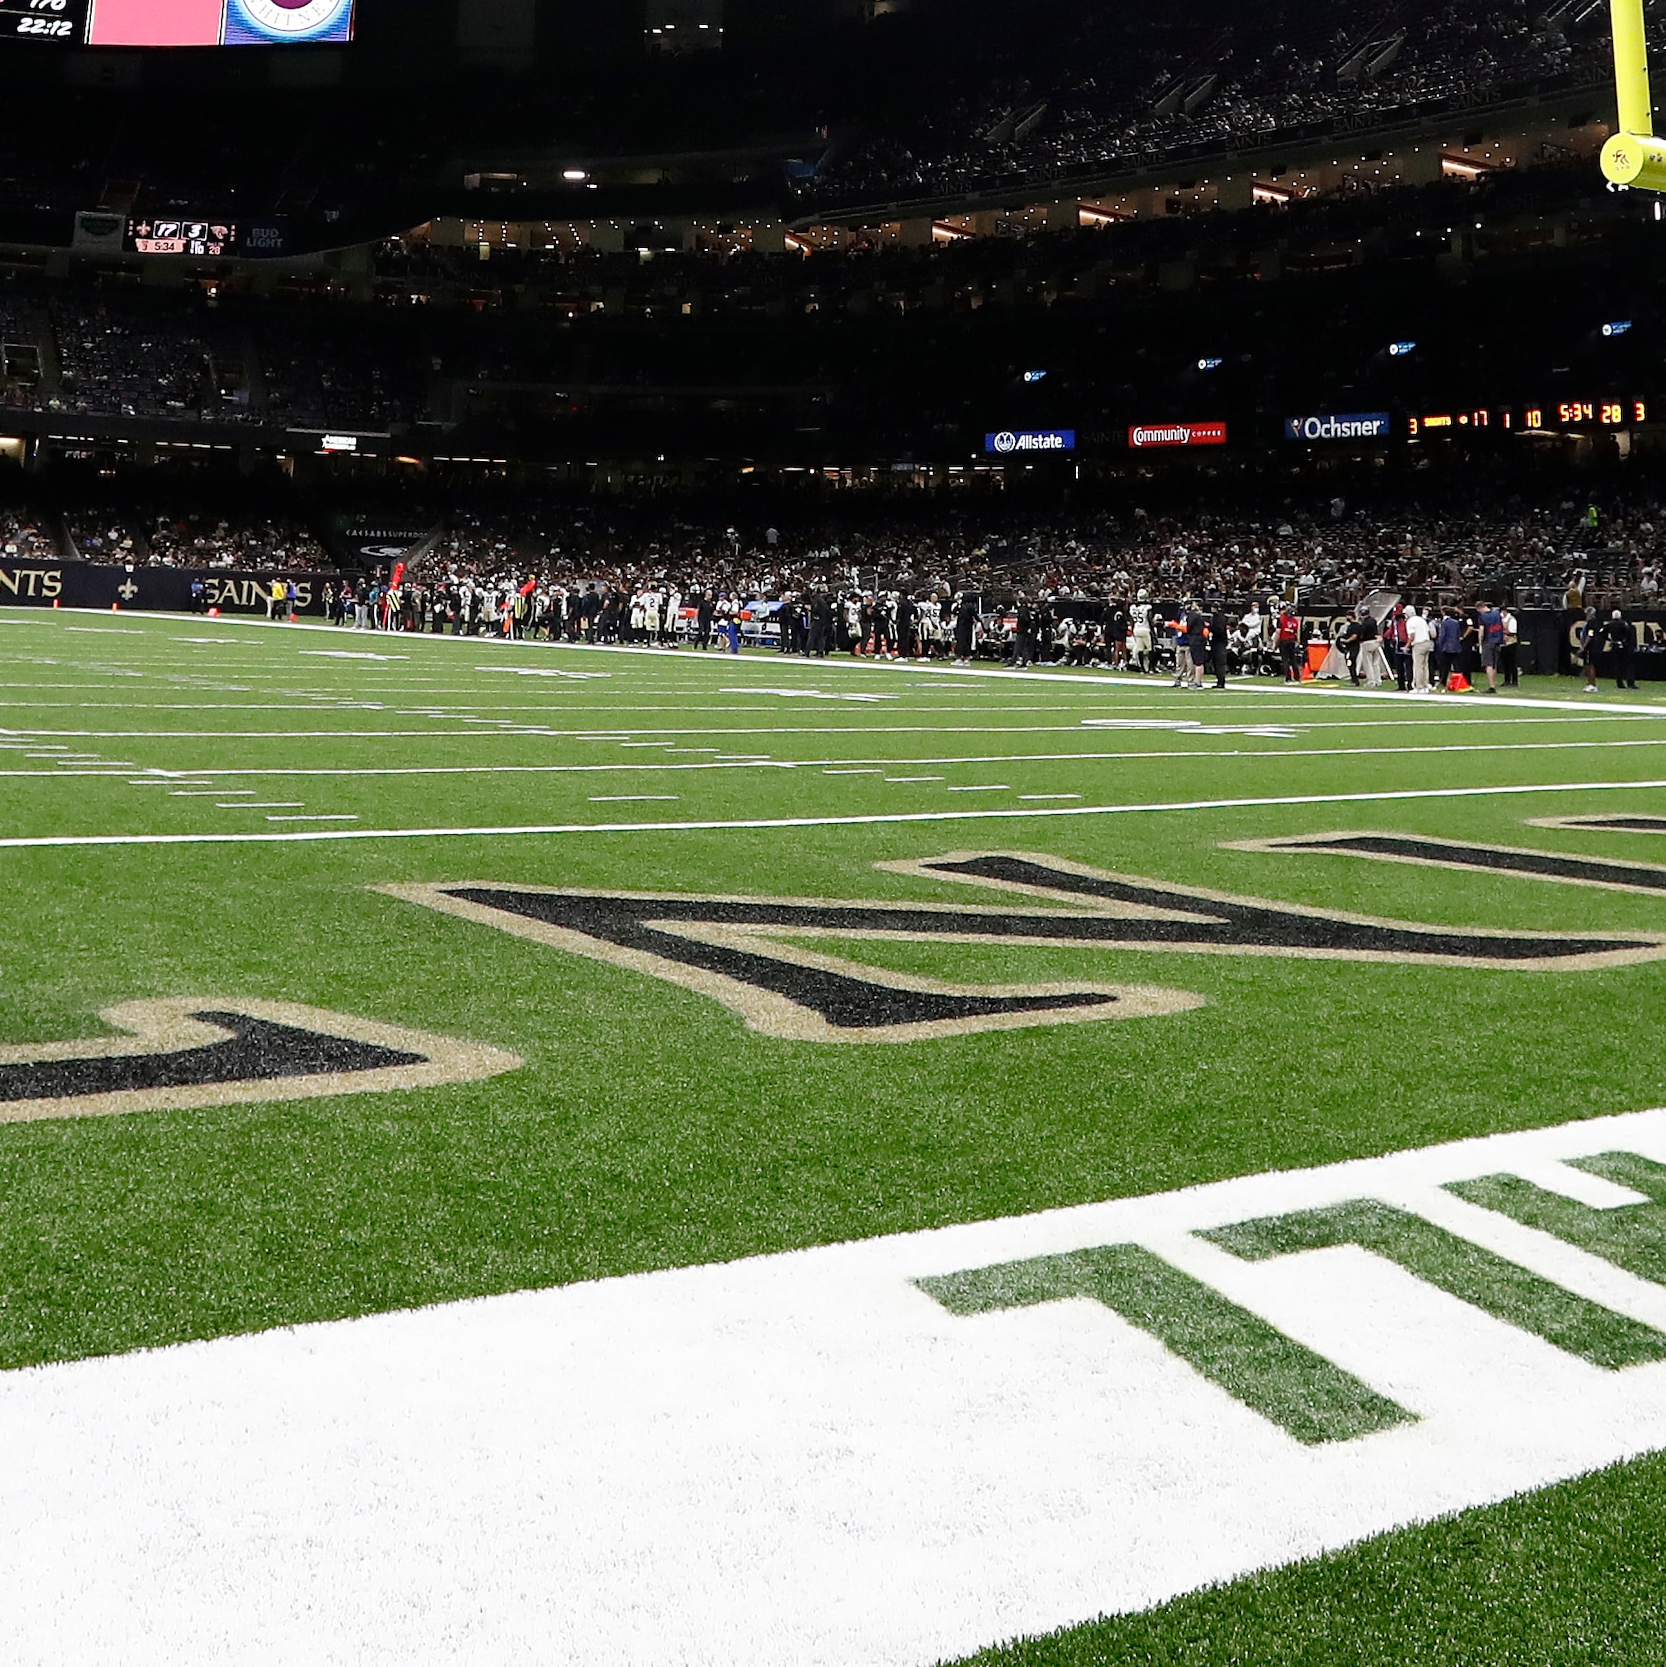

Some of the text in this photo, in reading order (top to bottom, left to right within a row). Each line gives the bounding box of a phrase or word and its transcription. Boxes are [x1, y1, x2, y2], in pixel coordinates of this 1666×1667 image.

[17, 17, 73, 36] 22:12
[157, 223, 178, 237] 17
[188, 224, 203, 238] 3
[251, 228, 279, 238] BUD
[154, 241, 175, 252] 5:34
[246, 237, 283, 249] LIGHT
[1408, 417, 1418, 435] 3
[1473, 410, 1488, 427] 17
[1504, 413, 1511, 429] 1
[1526, 410, 1541, 428] 10
[1560, 404, 1593, 422] 5:34
[1602, 404, 1622, 423] 28
[1635, 402, 1646, 421] 3
[1304, 416, 1383, 439] Ochsner
[1133, 425, 1222, 446] Community COFFEE
[346, 529, 387, 537] CAESARS
[205, 577, 312, 608] SAINS
